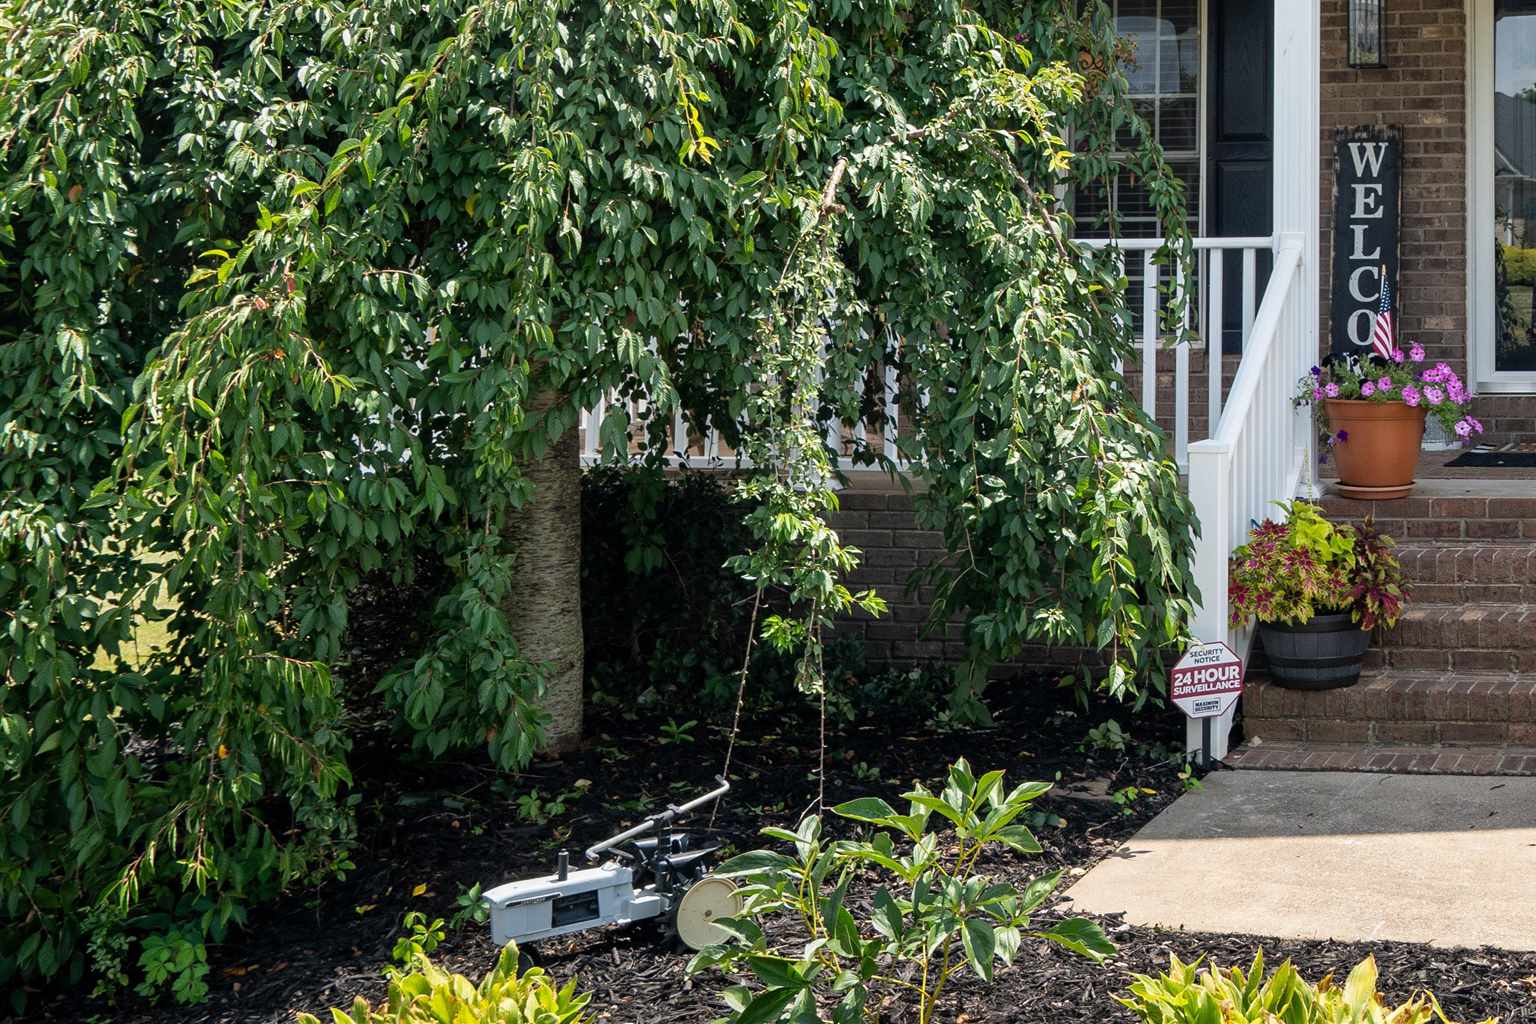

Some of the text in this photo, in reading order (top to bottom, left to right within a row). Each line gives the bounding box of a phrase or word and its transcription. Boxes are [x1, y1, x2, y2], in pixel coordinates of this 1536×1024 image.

[1190, 648, 1224, 658] SECURITY
[1194, 656, 1221, 664] NOTICE
[1174, 665, 1240, 686] 24 HOUR
[1173, 679, 1241, 696] SURVEILLANCE
